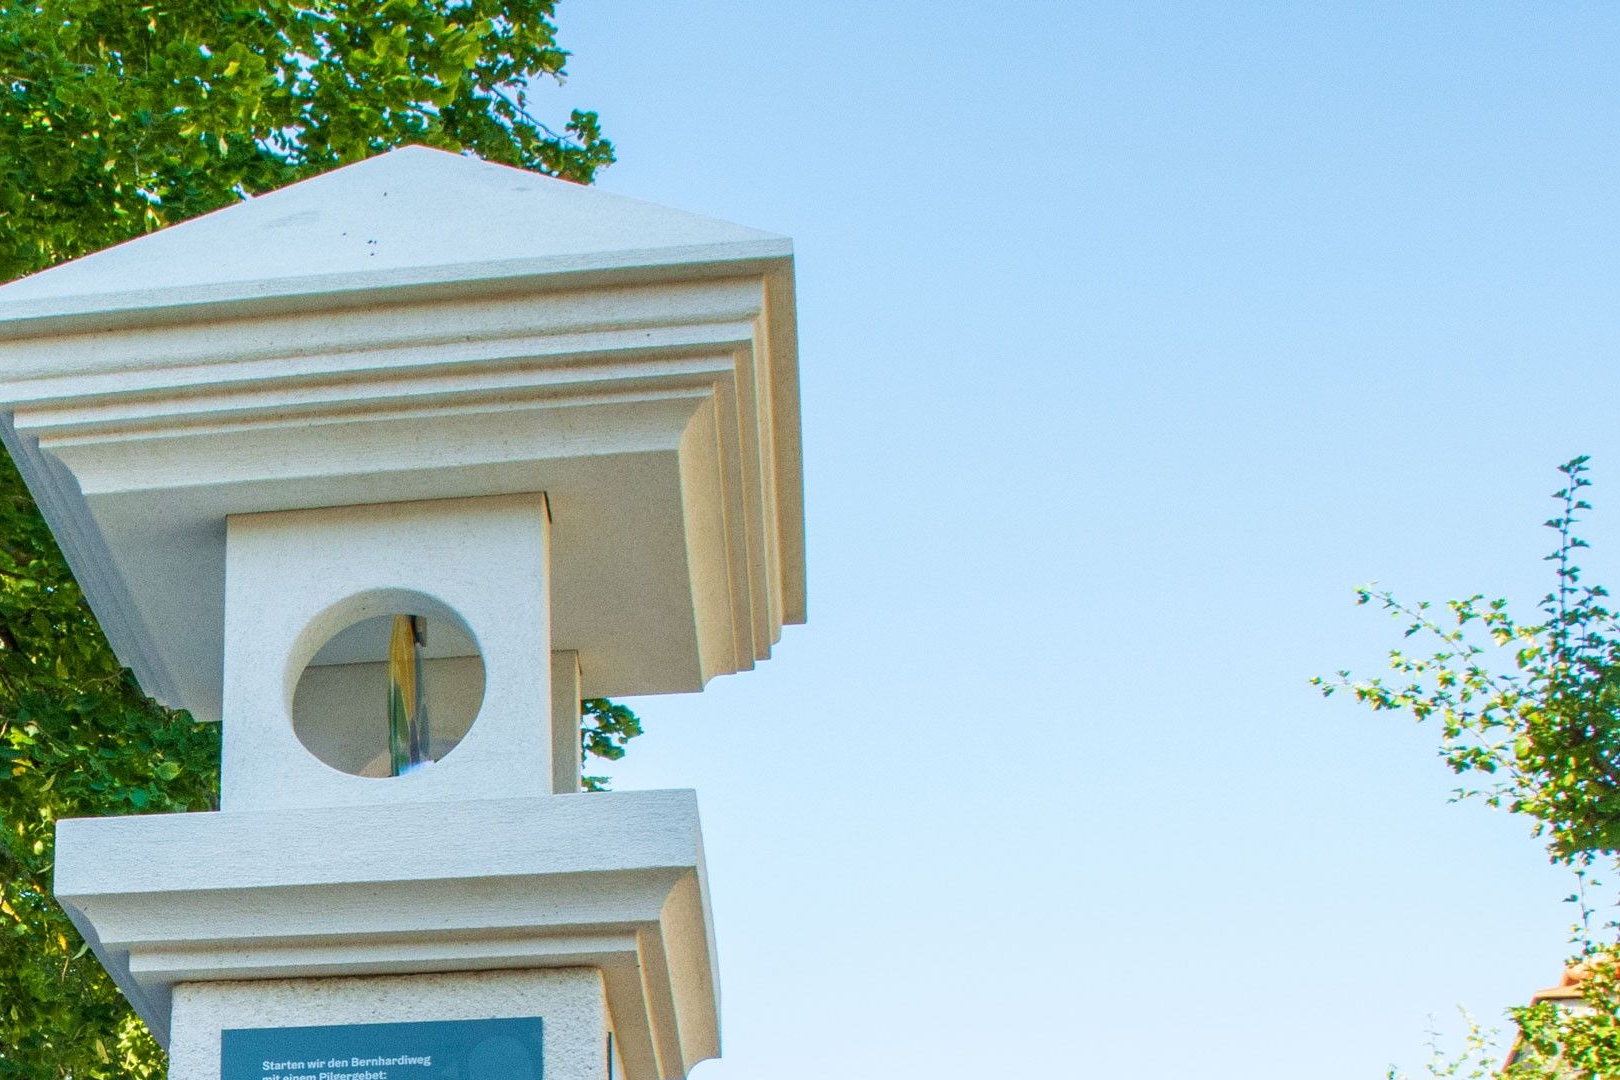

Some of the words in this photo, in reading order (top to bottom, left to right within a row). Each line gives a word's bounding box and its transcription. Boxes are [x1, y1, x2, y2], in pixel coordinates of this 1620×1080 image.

[262, 1060, 305, 1071] Starten
[307, 1059, 325, 1069] wir
[327, 1058, 348, 1068] den
[351, 1055, 431, 1067] Bernhardiweg
